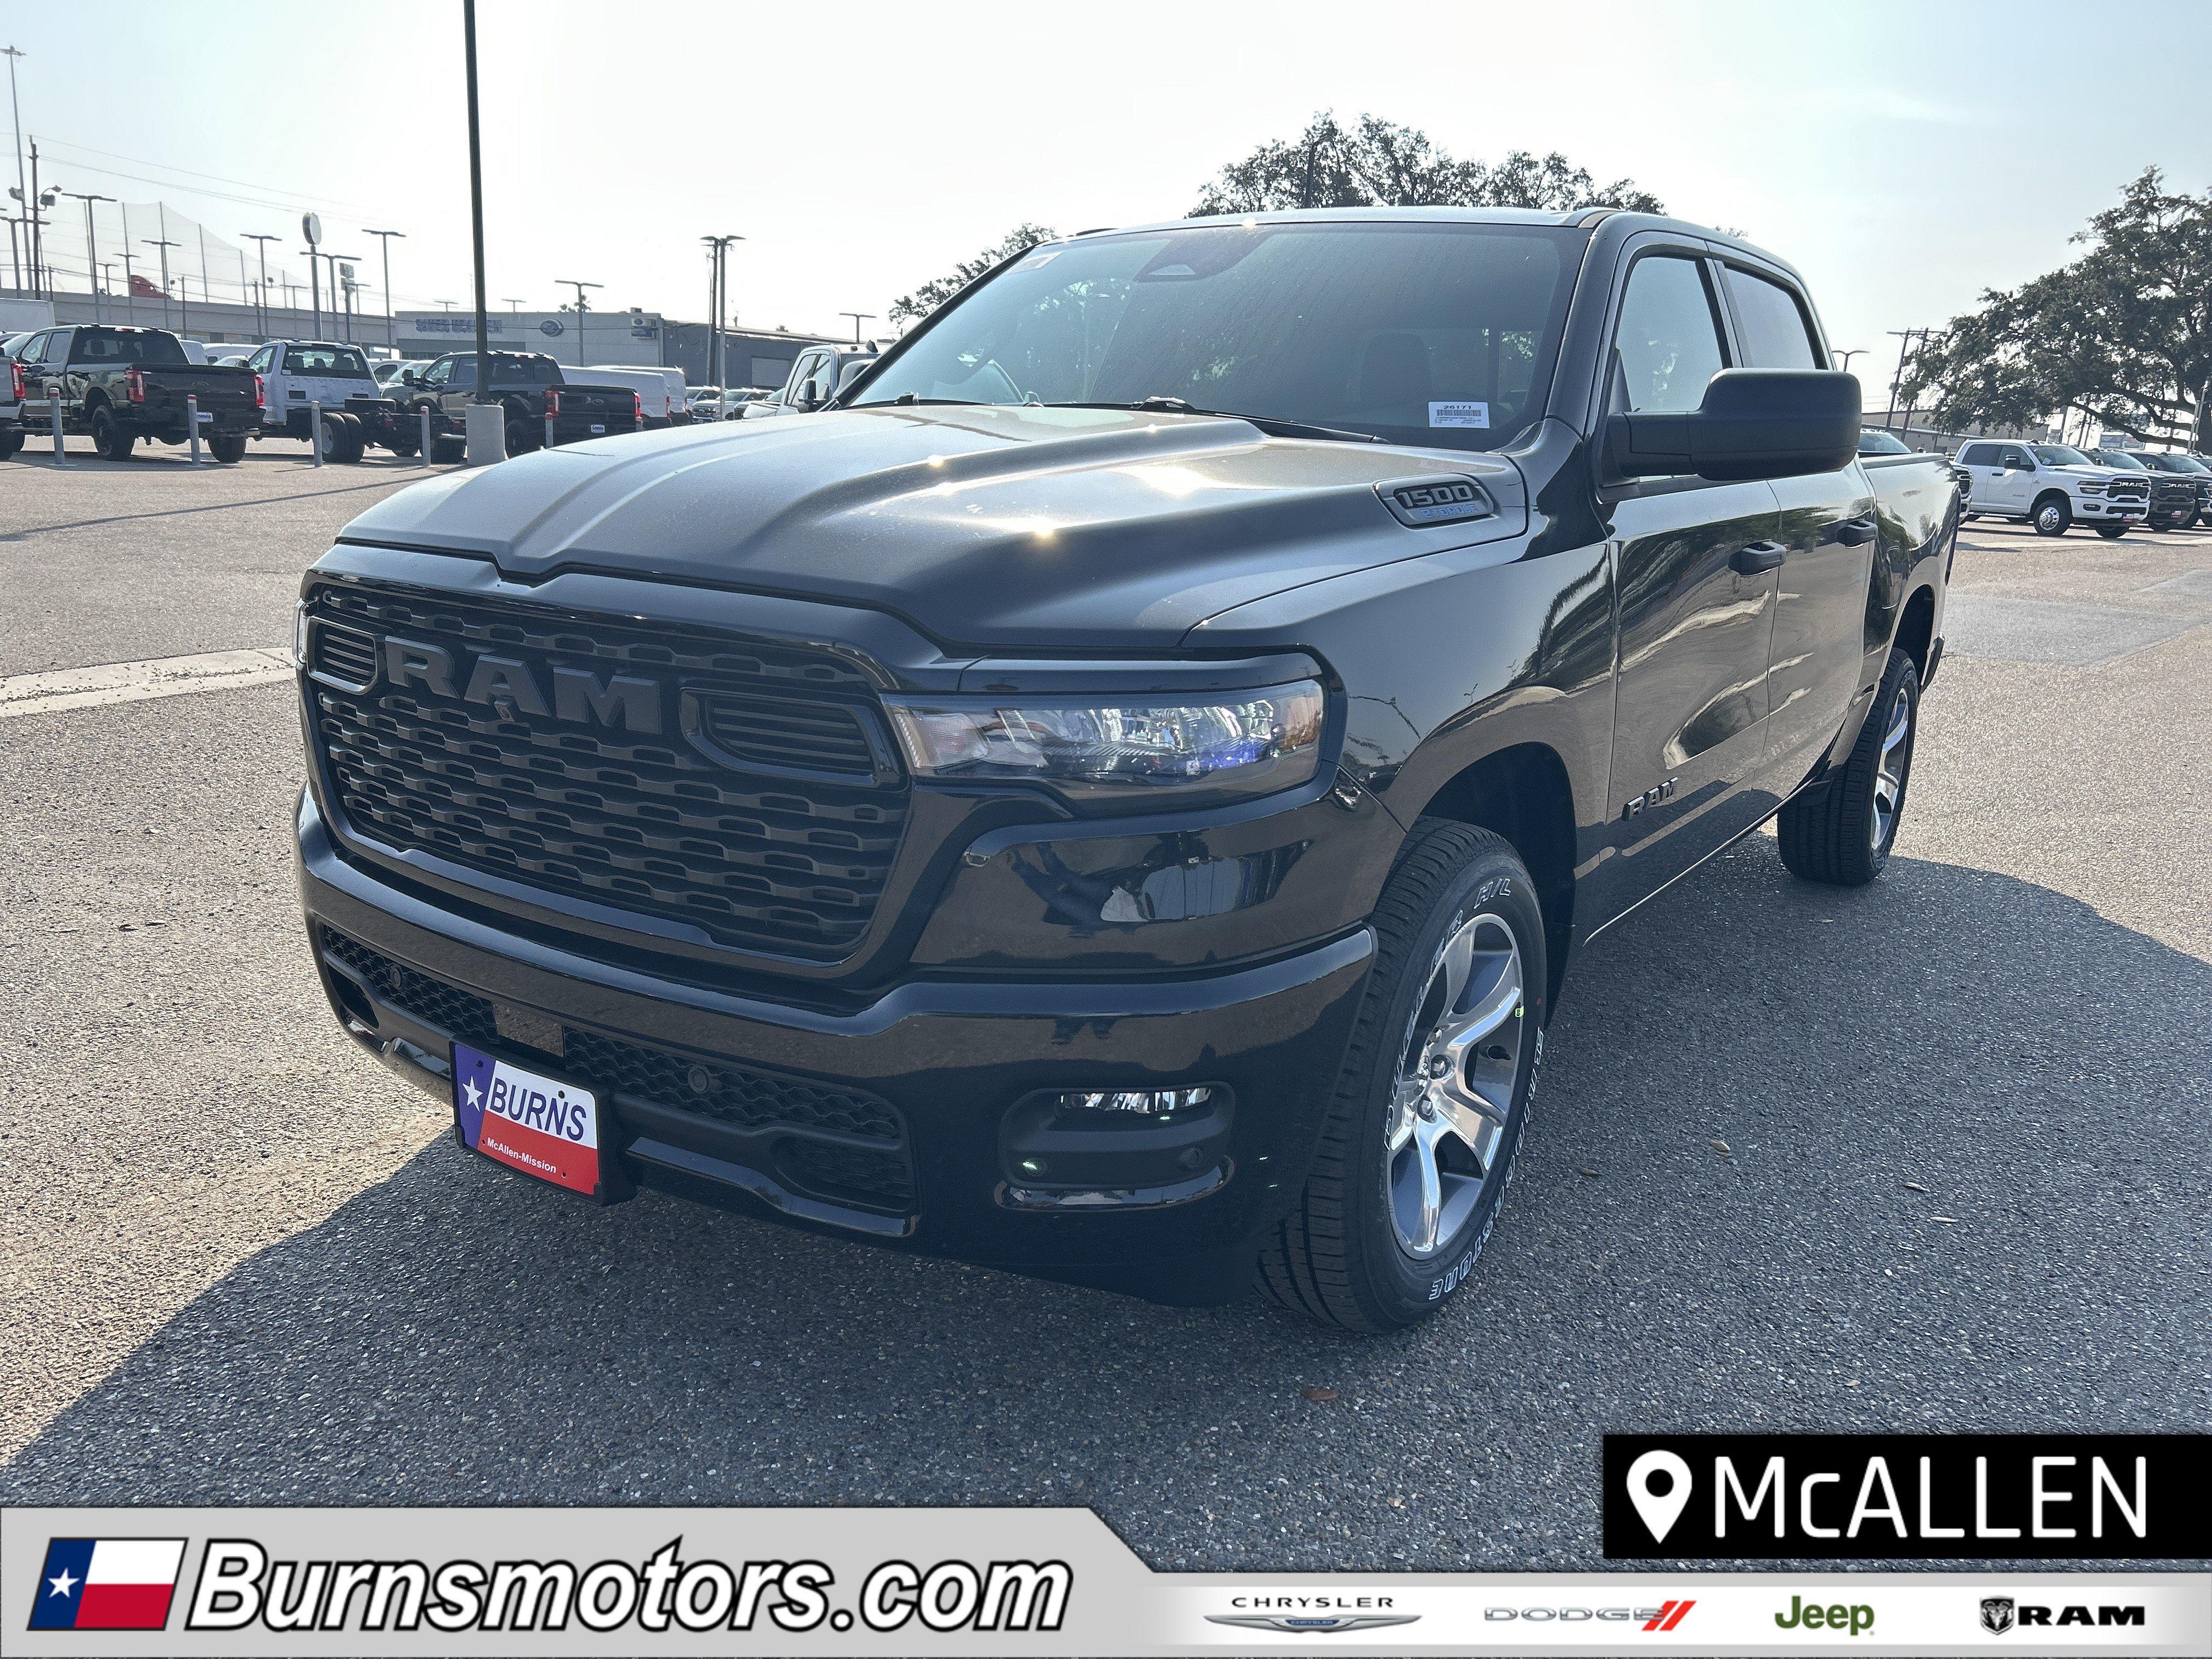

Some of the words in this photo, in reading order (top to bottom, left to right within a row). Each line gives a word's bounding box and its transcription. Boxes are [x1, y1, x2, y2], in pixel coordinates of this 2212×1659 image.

[1397, 485, 1473, 507] 1500
[385, 635, 662, 735] RAM
[1622, 777, 1678, 821] RAM
[489, 1077, 587, 1142] BURNS
[487, 1137, 557, 1173] McAllen-Mission
[1428, 1026, 1544, 1301] BRIDGESTONE
